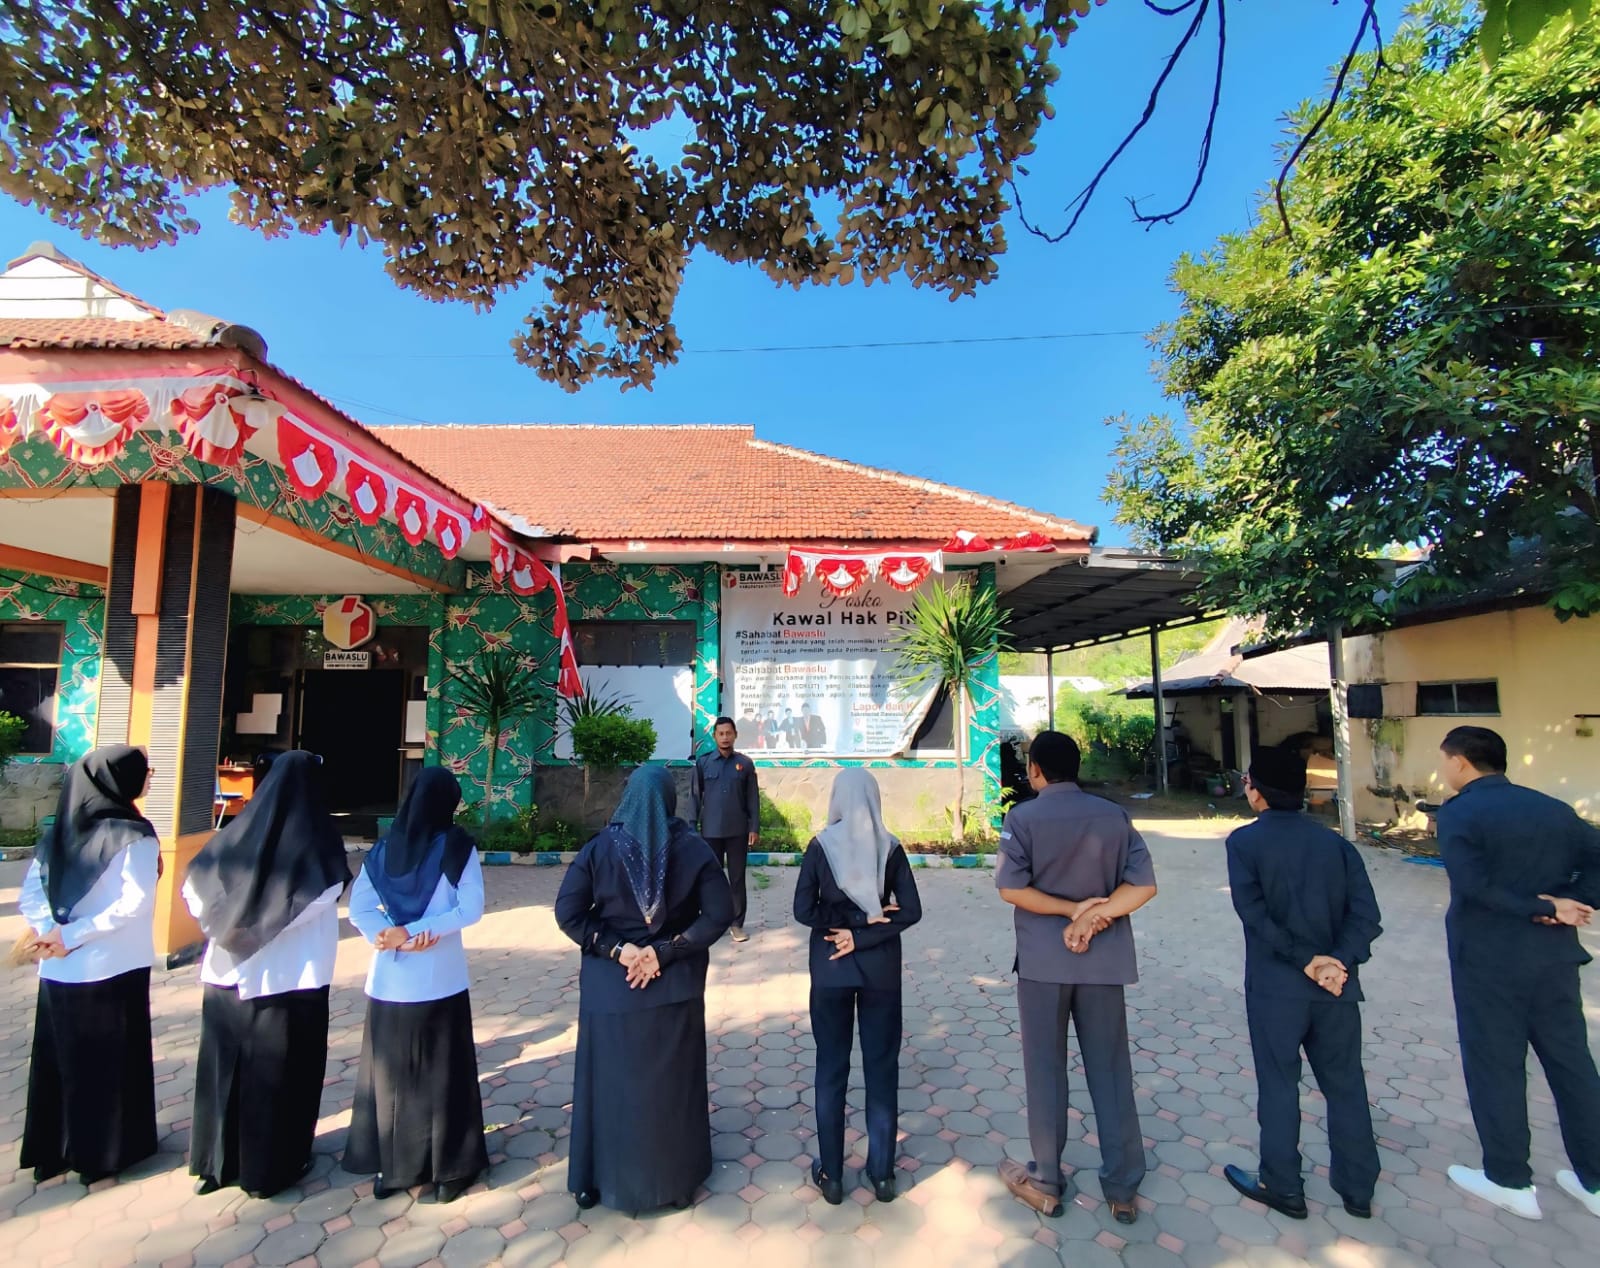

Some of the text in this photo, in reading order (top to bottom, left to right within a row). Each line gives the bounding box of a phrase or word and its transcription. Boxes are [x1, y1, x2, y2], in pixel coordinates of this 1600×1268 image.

[773, 611, 832, 626] Kawal
[841, 611, 877, 625] Hak
[735, 629, 826, 639] #Sahabat Bawaslu
[325, 652, 368, 661] BAWASLU
[784, 664, 827, 673] Bawaslu
